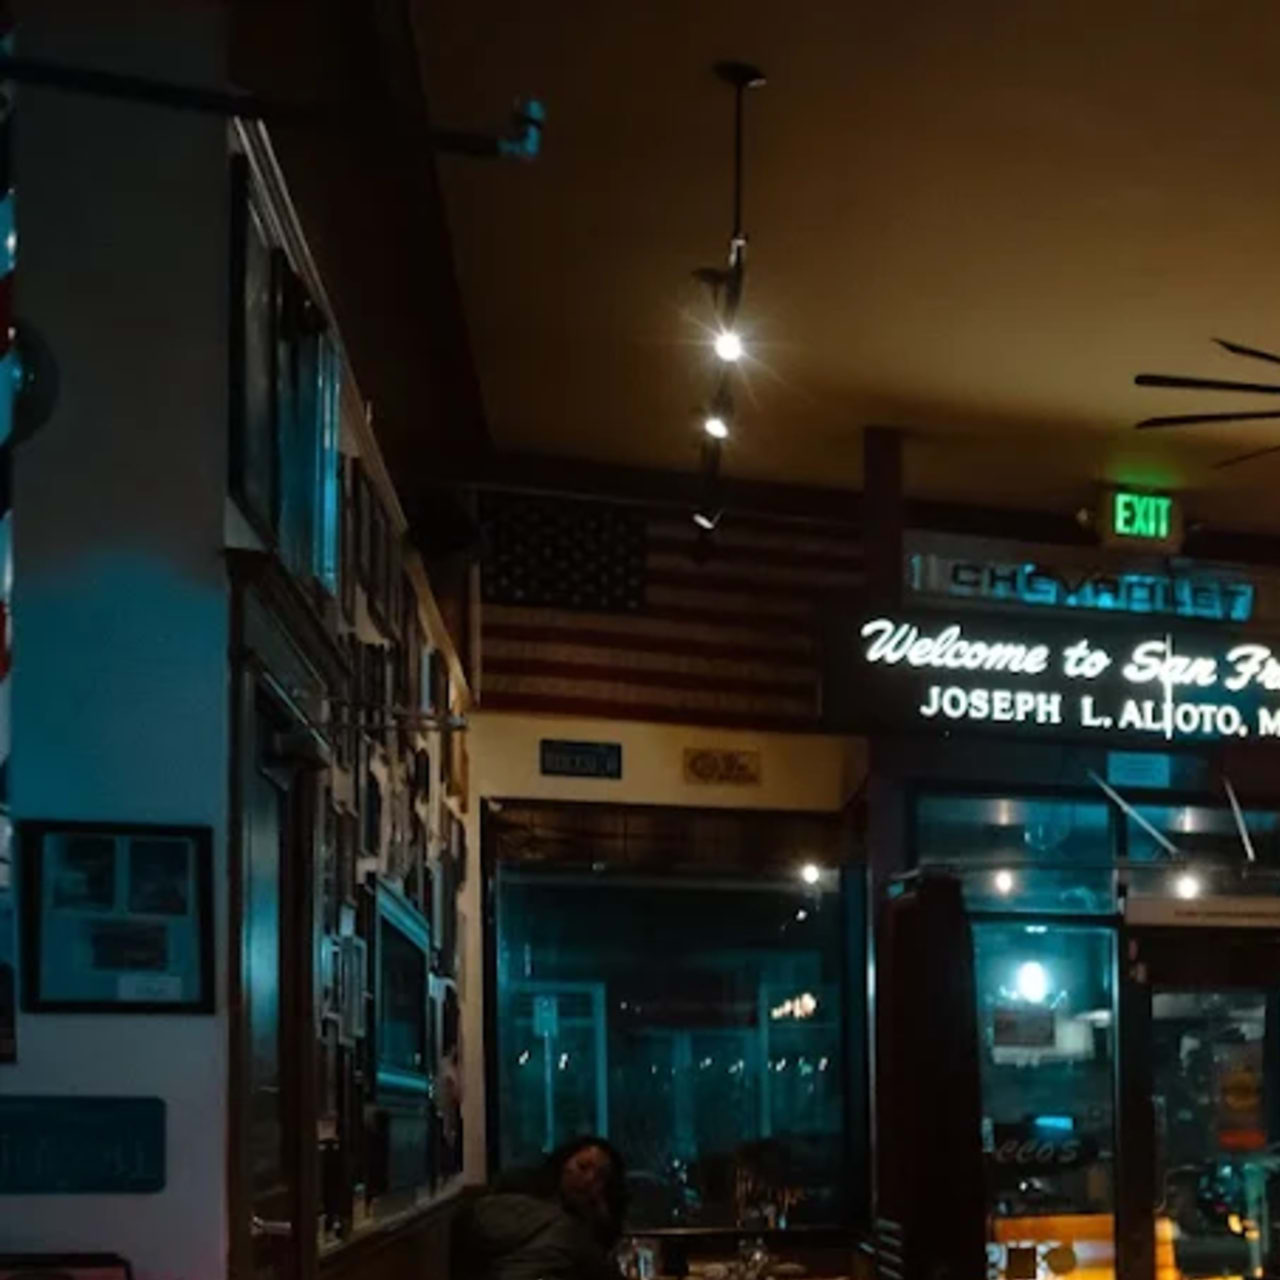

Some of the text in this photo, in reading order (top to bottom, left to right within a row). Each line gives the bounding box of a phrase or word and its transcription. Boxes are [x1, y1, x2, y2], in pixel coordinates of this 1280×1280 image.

[1115, 493, 1172, 539] EXIT
[861, 619, 1049, 675] Welcome
[1062, 639, 1112, 678] to
[1122, 640, 1217, 686] San
[920, 685, 1062, 724] JOSEPH
[1081, 695, 1113, 729] L.
